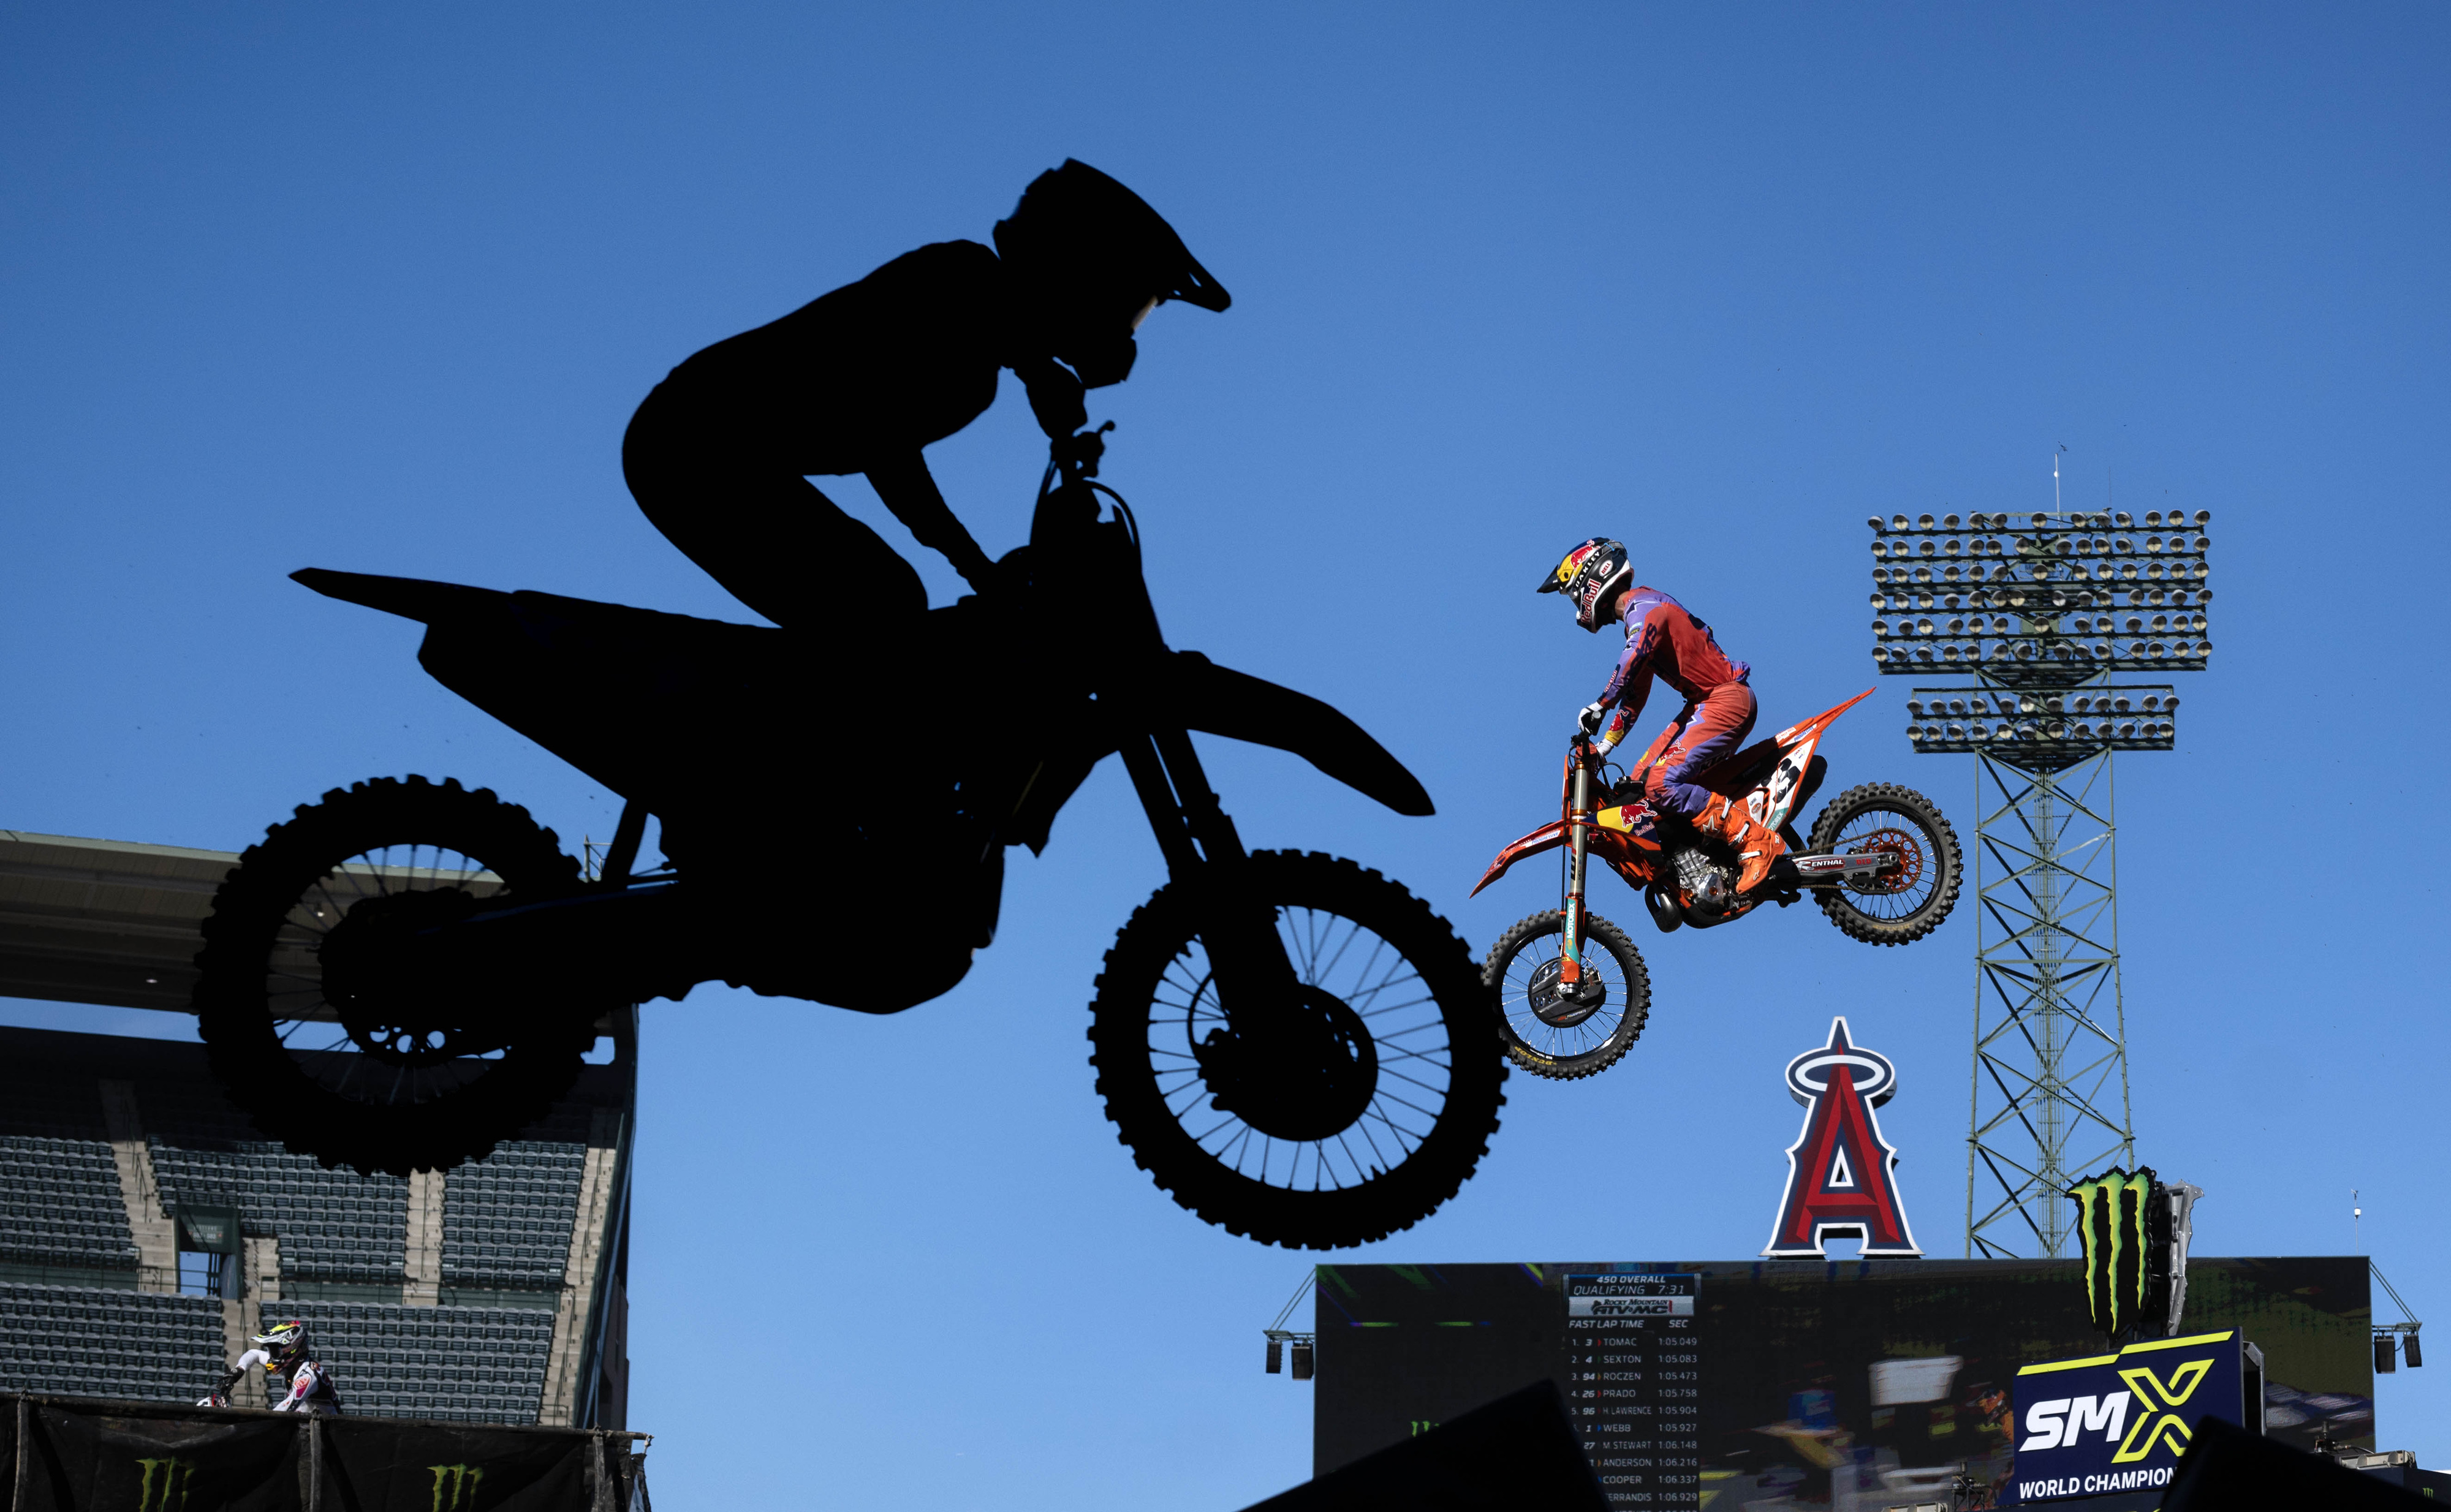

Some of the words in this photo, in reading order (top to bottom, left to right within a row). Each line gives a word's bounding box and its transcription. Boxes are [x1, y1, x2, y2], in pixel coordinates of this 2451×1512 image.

[1601, 562, 1612, 575] BELL
[1769, 811, 1784, 831] OTOREX
[1531, 831, 1559, 845] PROGRESSIVE
[1566, 902, 1575, 939] MOTOREX
[1596, 1276, 1617, 1284] 450
[1619, 1275, 1666, 1284] OVERALL
[1573, 1285, 1646, 1296] QUALIFYING
[1658, 1285, 1684, 1295] 7:31
[1569, 1320, 1596, 1329] FAST
[1597, 1320, 1618, 1329] LAP
[1619, 1320, 1645, 1328] TIME
[1669, 1319, 1689, 1328] SEC
[1585, 1338, 1593, 1347] 3
[1603, 1337, 1637, 1347] TOMAC
[1658, 1337, 1697, 1346] 1:05.049
[1603, 1355, 1642, 1364] SEXTON
[1658, 1355, 1697, 1363] 1:05.083
[1571, 1372, 1578, 1381] 3.
[1582, 1372, 1596, 1381] 94
[1603, 1372, 1642, 1381] ROCZEN
[1658, 1372, 1697, 1380] 1:05.473
[1582, 1389, 1596, 1399] 26
[1603, 1389, 1636, 1398] PRADO
[1658, 1388, 1697, 1397] 1:05.758
[1571, 1407, 1579, 1415] 5.
[1582, 1407, 1596, 1416] 96
[1611, 1406, 1652, 1415] LAWRENCE
[1658, 1406, 1697, 1415] 1:05.904
[2018, 1358, 2216, 1464] SMX
[1585, 1424, 1592, 1433] 1
[1603, 1423, 1631, 1432] WEBB
[1658, 1423, 1697, 1432] 1:05.927
[1583, 1441, 1596, 1450] 27
[1613, 1440, 1652, 1450] STEWART
[1658, 1440, 1697, 1450] 1:06.148
[1602, 1458, 1652, 1467] ANDERSON
[1658, 1457, 1697, 1467] 1:06.216
[1602, 1475, 1642, 1484] COOPER
[1658, 1475, 1697, 1484] 1:06.337
[2018, 1476, 2080, 1500] WORLD
[1658, 1492, 1698, 1502] 1:06.929
